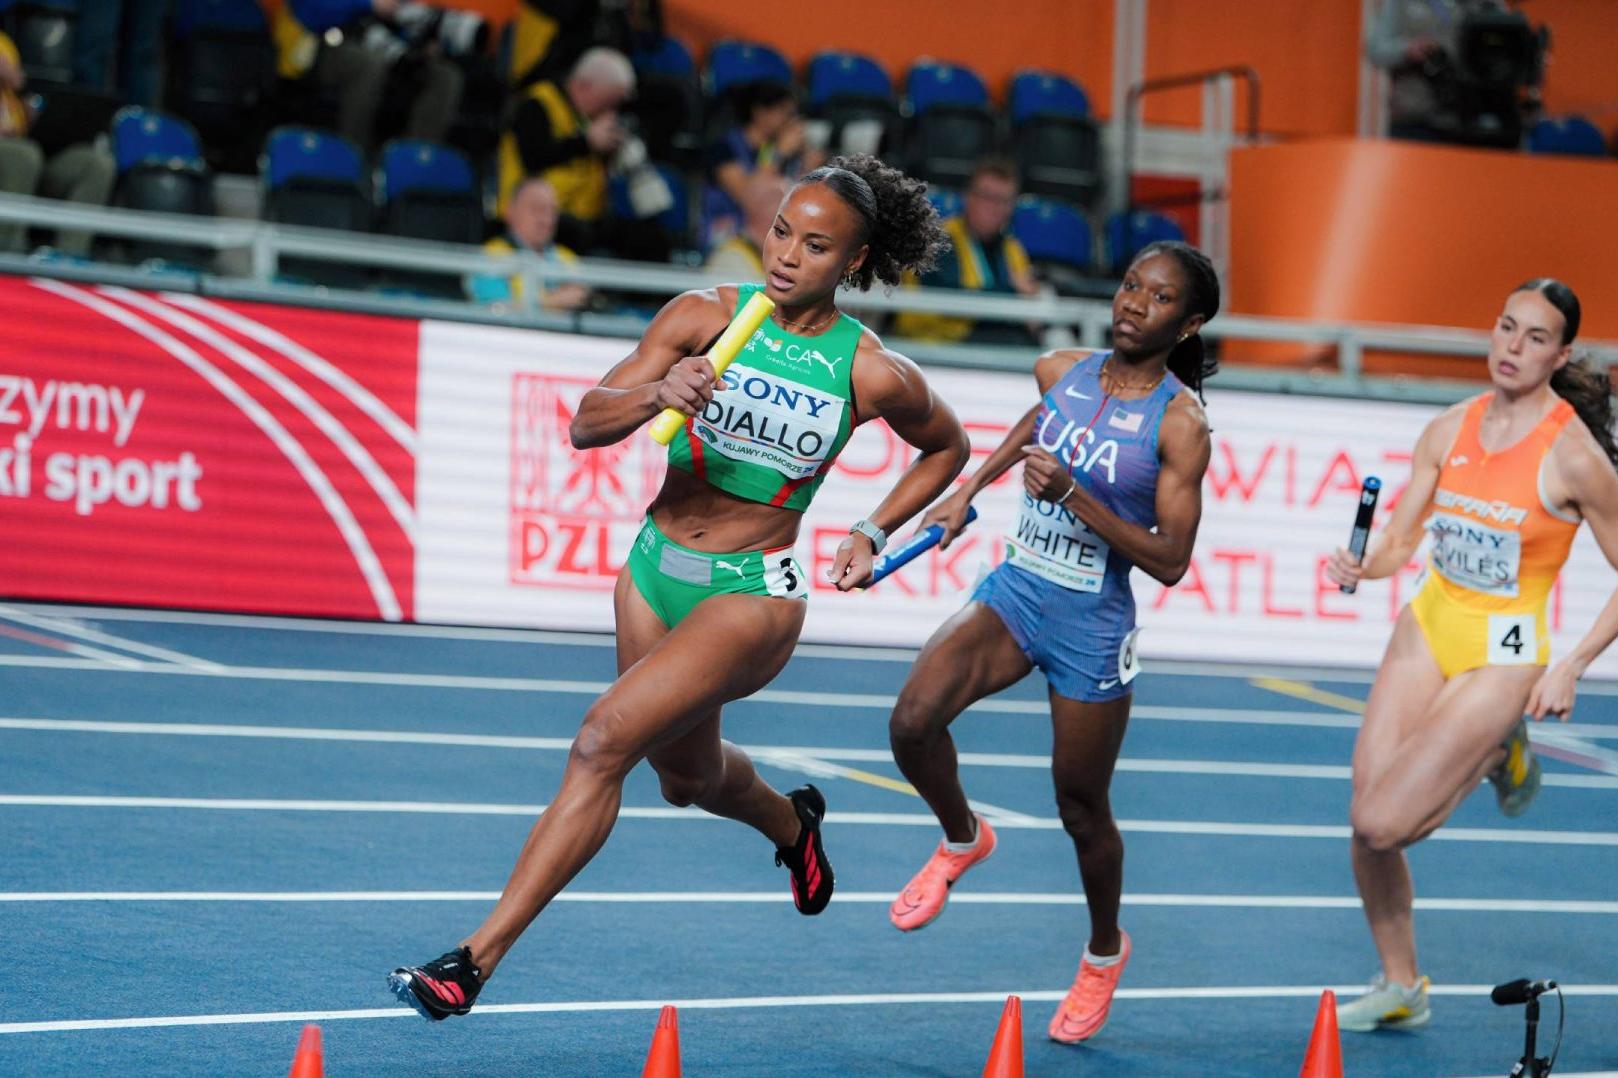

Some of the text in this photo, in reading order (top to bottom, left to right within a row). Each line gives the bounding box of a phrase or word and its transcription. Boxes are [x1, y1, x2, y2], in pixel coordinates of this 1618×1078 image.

[719, 368, 831, 418] SONY
[701, 400, 823, 457] DIALLO
[1038, 408, 1119, 484] USA
[722, 440, 804, 474] KUJAWY POMORZE
[45, 451, 203, 516] sport
[1024, 494, 1093, 535] SON
[1016, 514, 1098, 568] WHITE
[1501, 624, 1524, 654] 4
